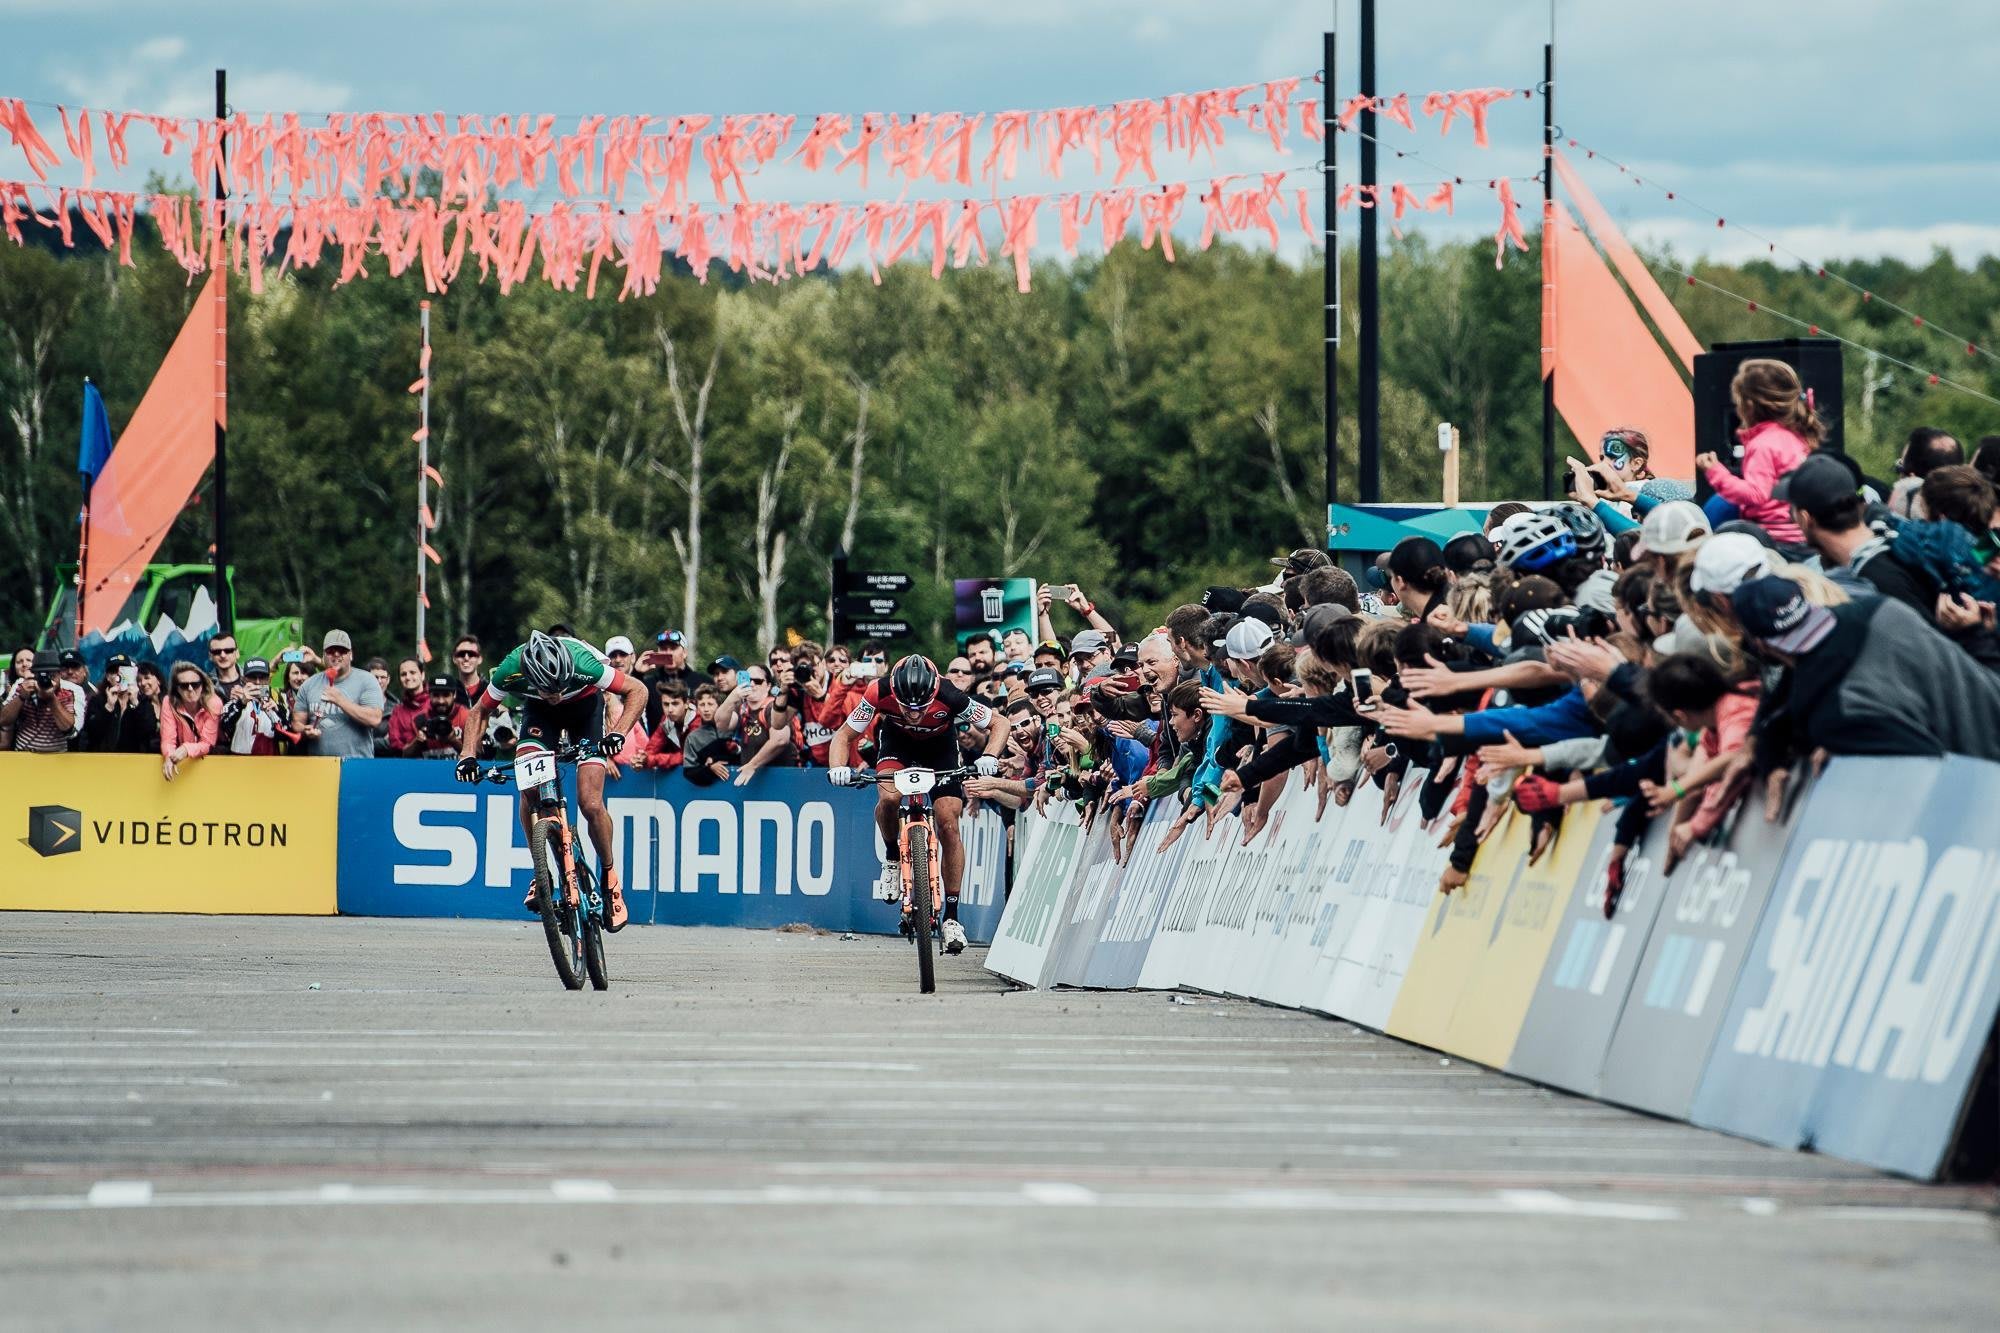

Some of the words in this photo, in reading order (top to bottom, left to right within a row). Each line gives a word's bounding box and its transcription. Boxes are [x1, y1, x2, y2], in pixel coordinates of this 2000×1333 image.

[524, 759, 546, 777] 14
[908, 772, 921, 785] 8
[93, 815, 287, 847] VIDÉOTRON
